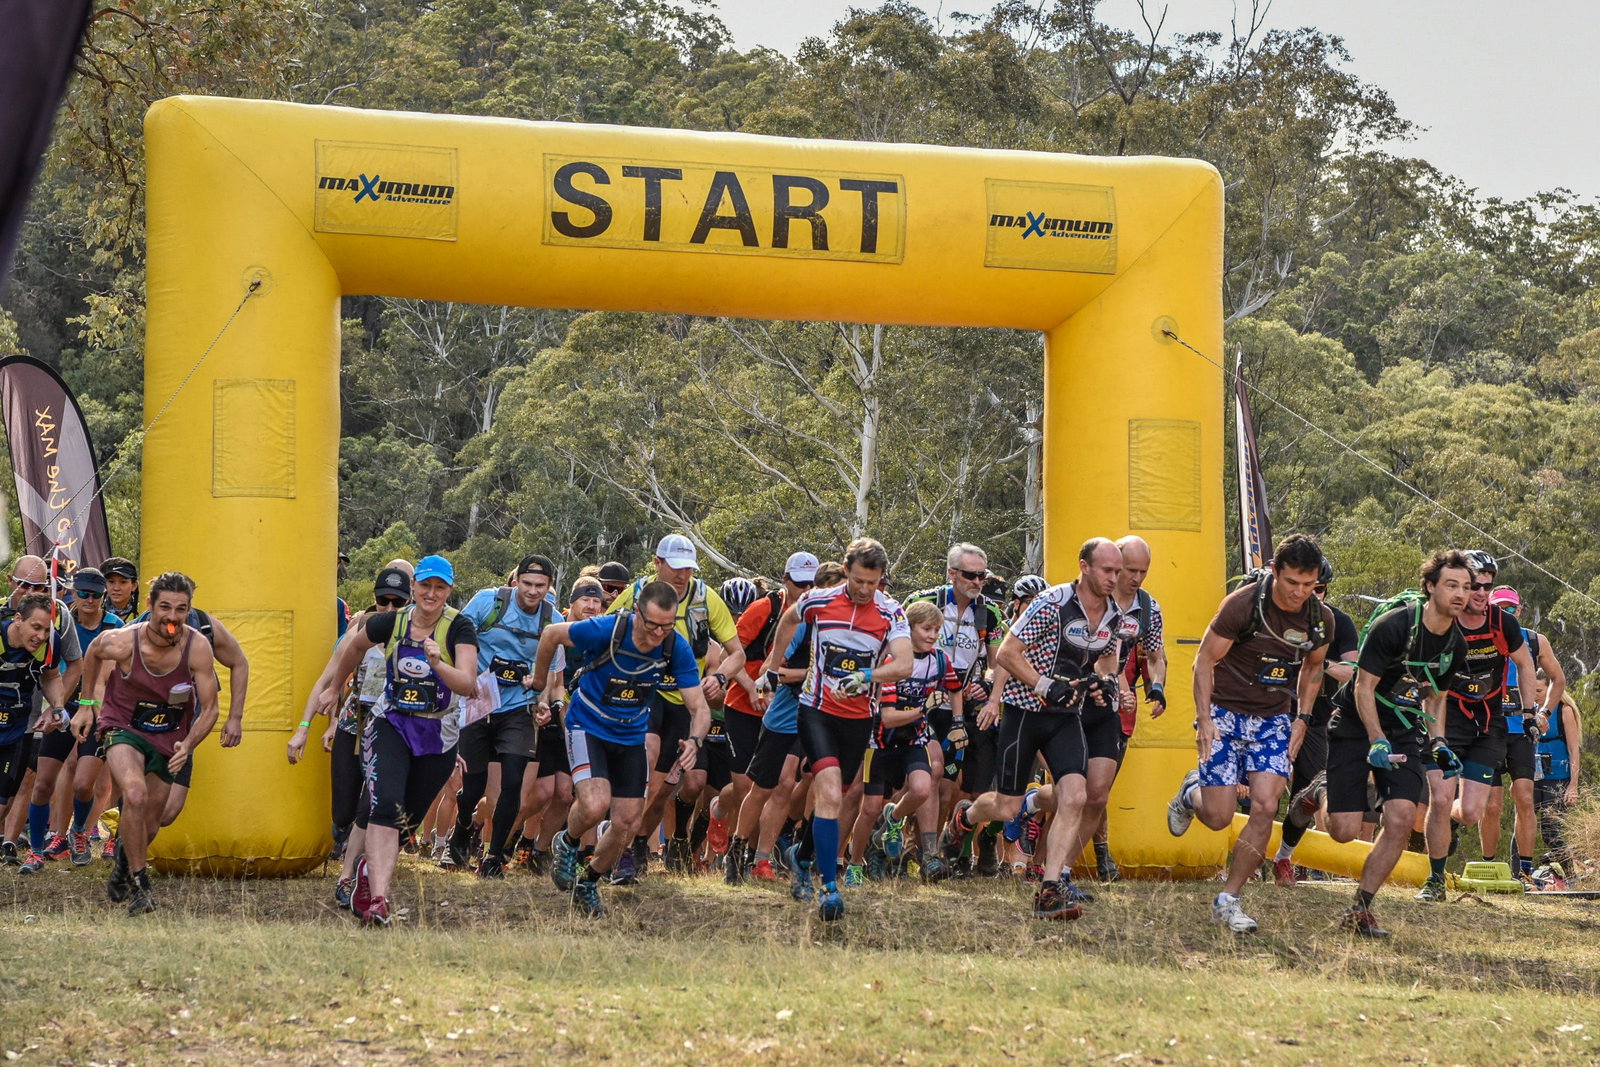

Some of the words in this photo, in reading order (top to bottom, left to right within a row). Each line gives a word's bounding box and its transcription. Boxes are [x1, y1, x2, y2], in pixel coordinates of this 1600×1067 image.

[384, 194, 452, 206] Adventure
[550, 161, 899, 253] START
[1049, 231, 1111, 241] Adventure
[841, 658, 856, 670] 68
[502, 669, 515, 679] 82
[1271, 667, 1284, 678] 83
[620, 689, 635, 699] 68
[1468, 684, 1479, 693] 91
[404, 689, 418, 701] 32
[151, 713, 166, 724] 47
[711, 726, 721, 735] 87
